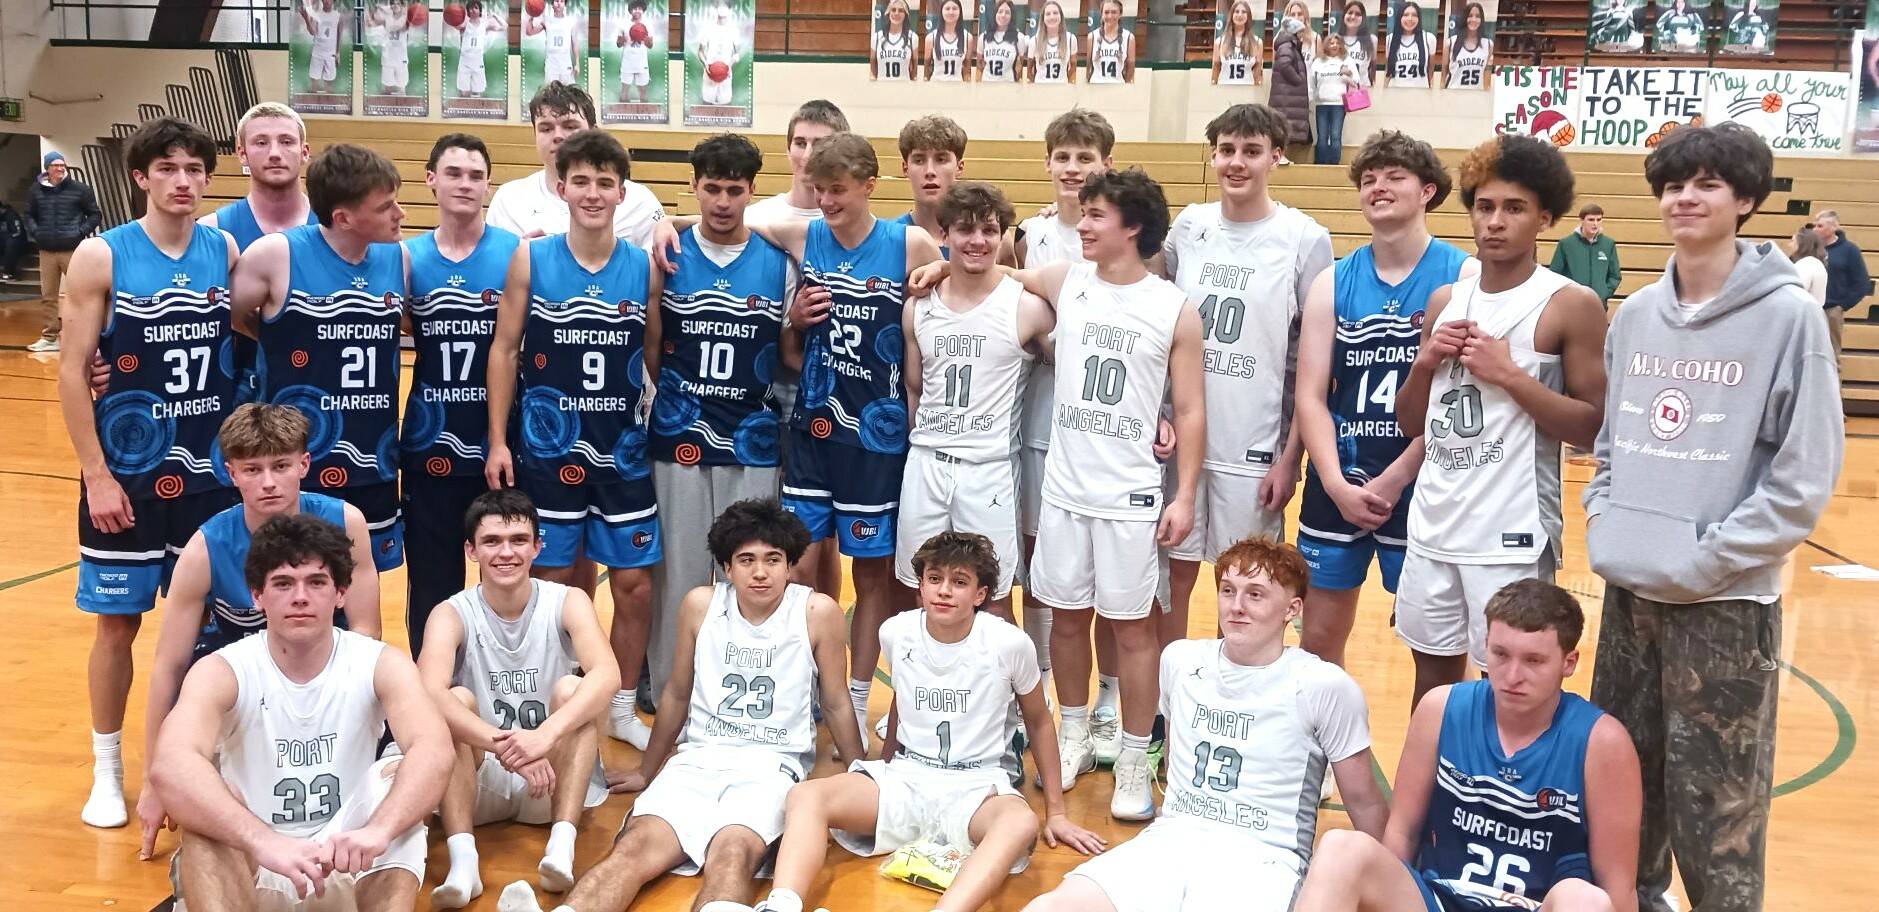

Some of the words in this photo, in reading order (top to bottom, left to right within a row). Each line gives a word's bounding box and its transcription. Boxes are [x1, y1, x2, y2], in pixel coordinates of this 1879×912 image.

[554, 36, 563, 46] 10
[880, 49, 907, 60] RIDERS
[886, 62, 900, 77] 10
[944, 60, 955, 75] 11
[989, 61, 1003, 76] 12
[1046, 63, 1060, 79] 13
[1101, 61, 1116, 77] 14
[1229, 64, 1245, 79] 15
[1398, 64, 1417, 78] 24
[1461, 70, 1480, 85] 25
[1538, 66, 1577, 90] THE
[1585, 69, 1660, 95] TAKE
[1666, 69, 1708, 96] IT
[1710, 71, 1748, 101] May
[1756, 72, 1797, 94] all
[1803, 78, 1848, 103] your
[1585, 96, 1621, 117] TO
[1645, 96, 1702, 117] THE
[1581, 119, 1648, 146] HOOP
[1772, 135, 1806, 149] come
[1809, 132, 1841, 150] true
[1198, 262, 1255, 290] PORT
[830, 302, 878, 320] COAST
[1198, 293, 1245, 344] 40
[144, 321, 220, 343] SURFCOAST
[317, 324, 395, 340] SURFCOAST
[421, 320, 496, 337] SURFCOAST
[554, 329, 630, 346] SURFCOAST
[681, 320, 758, 339] SURFCOAST
[829, 318, 862, 362] 22
[1082, 322, 1141, 354] PORT
[934, 334, 986, 357] PORT
[163, 346, 211, 394] 37
[341, 346, 376, 388] 21
[440, 341, 476, 381] 17
[582, 351, 605, 390] 9
[699, 341, 734, 380] 10
[1203, 348, 1256, 379] ELES
[1627, 351, 1667, 378] M.V.
[1671, 359, 1744, 387] COHO
[680, 380, 747, 400] CHARGERS
[944, 363, 972, 408] 11
[1082, 355, 1126, 405] 10
[1356, 370, 1398, 414] 14
[152, 396, 221, 420] CHARGERS
[320, 394, 390, 411] CHARGERS
[423, 388, 487, 402] CHARGER
[559, 396, 626, 412] CHARGERS
[1058, 404, 1144, 441] ANGELES
[1431, 384, 1484, 438] 30
[1340, 420, 1405, 438] CHARGER
[1640, 443, 1689, 460] Northwest
[1690, 448, 1731, 461] Classic
[95, 586, 129, 595] CHARGERS
[724, 641, 777, 669] PORT
[488, 668, 538, 695] PORT
[717, 673, 775, 720] 23
[914, 686, 971, 713] PORT
[1191, 703, 1255, 740] PORT
[274, 733, 337, 768] PORT
[936, 721, 950, 767] 1
[1192, 740, 1243, 792] 13
[272, 773, 341, 824] 33
[1452, 806, 1553, 852] SURFCOAST
[1459, 842, 1531, 898] 26
